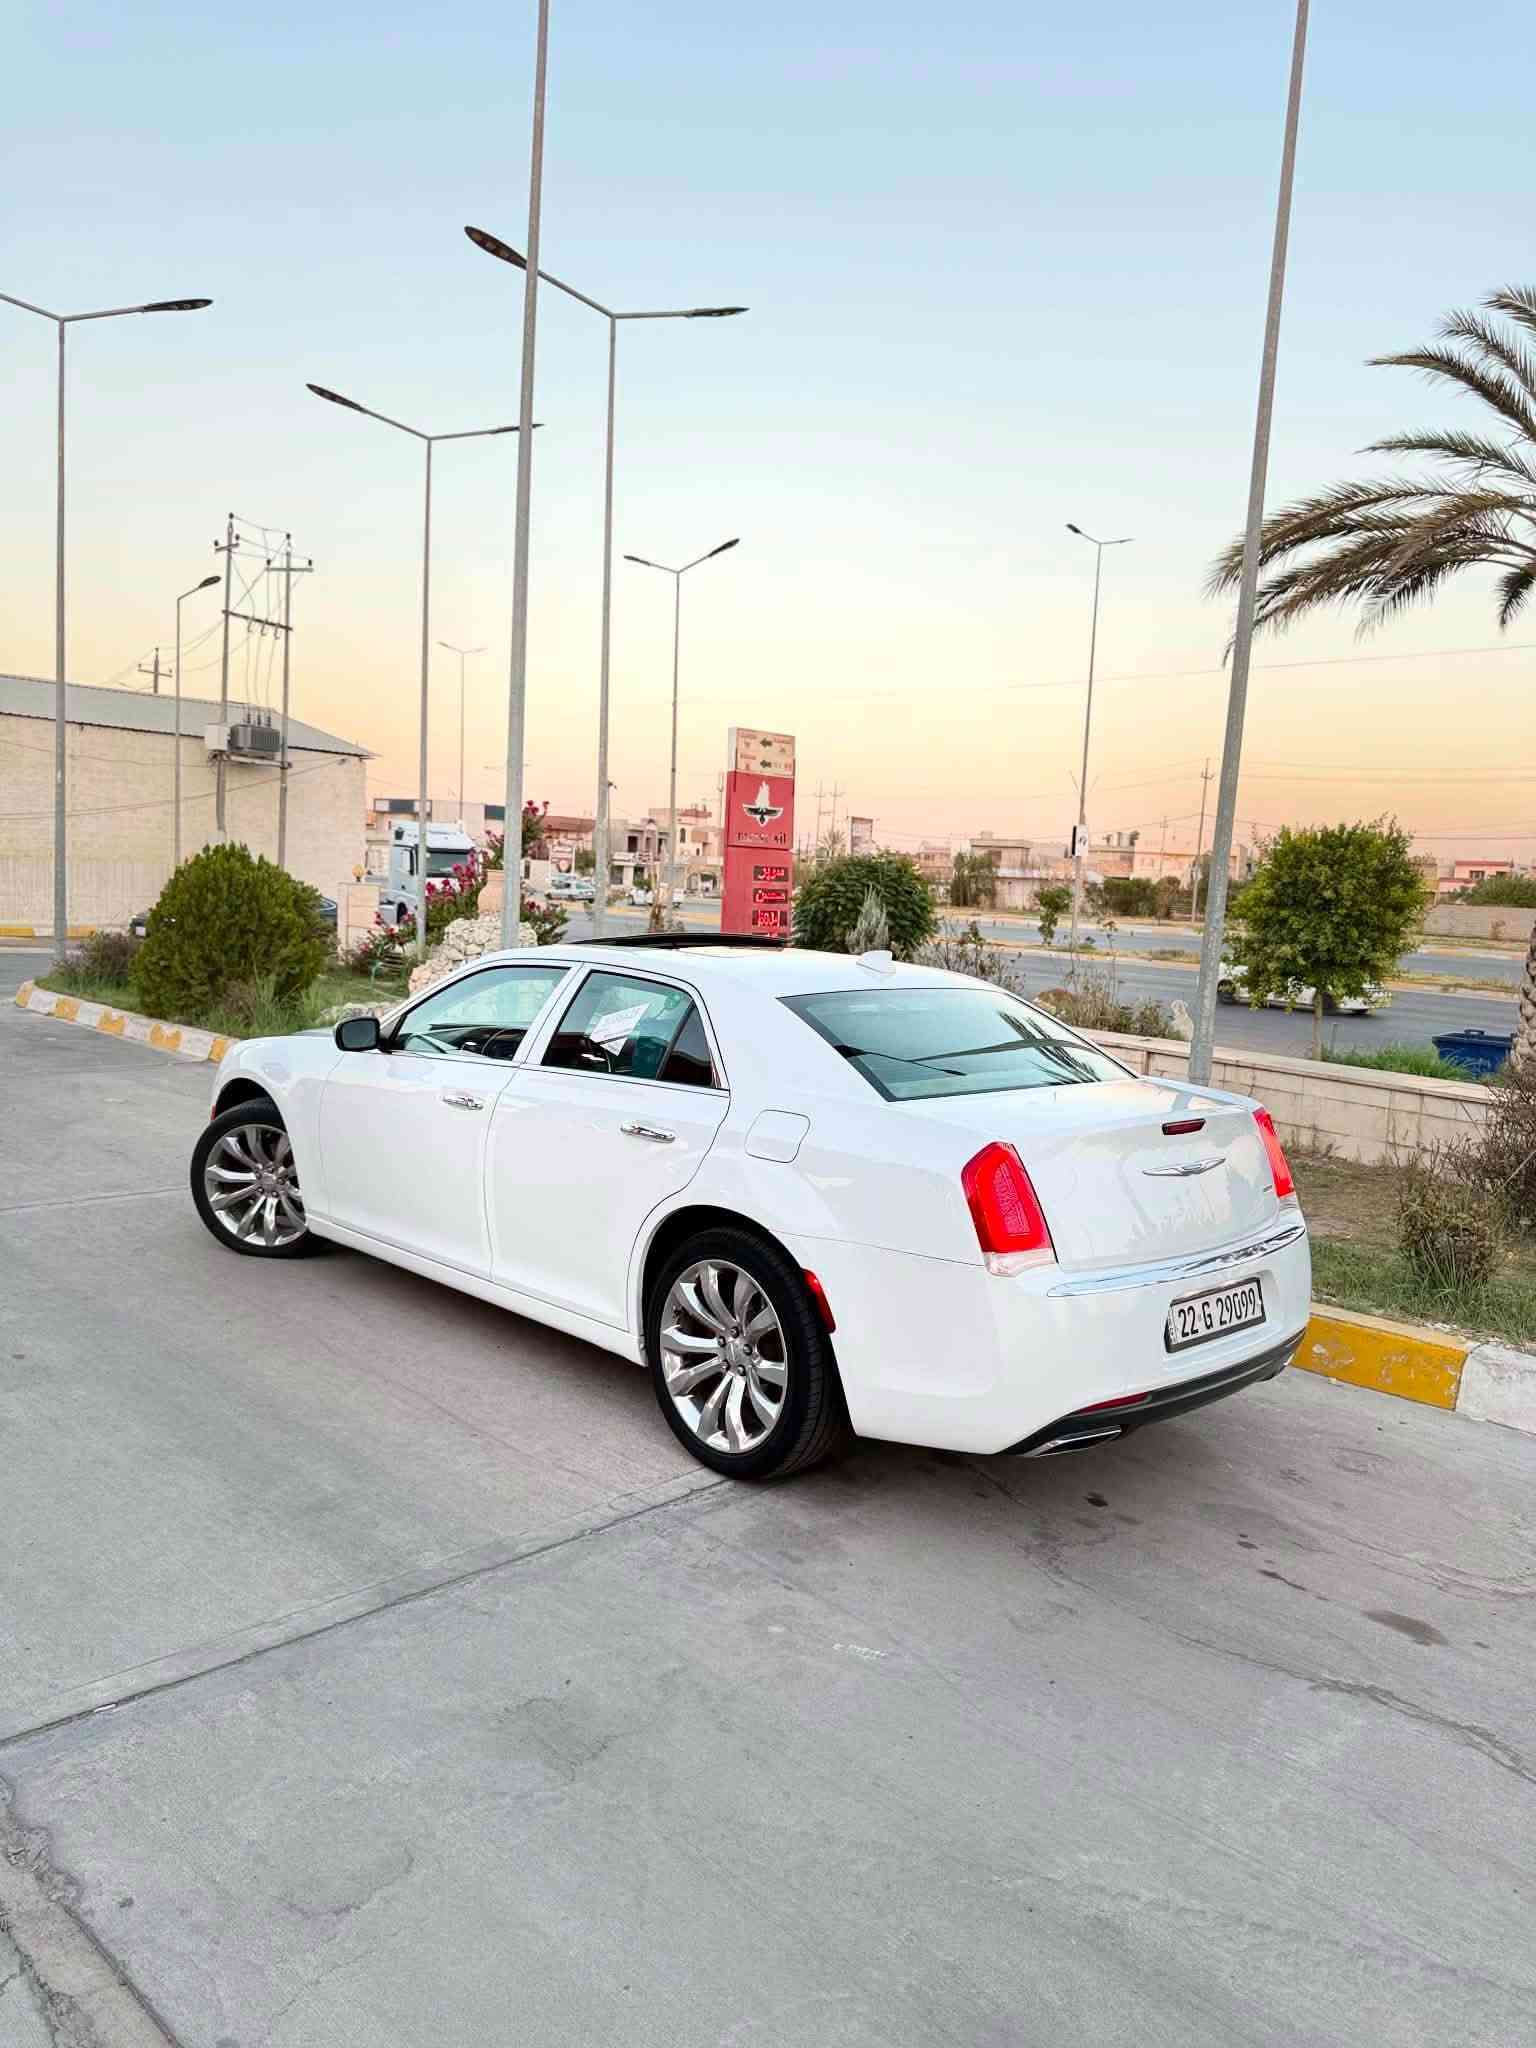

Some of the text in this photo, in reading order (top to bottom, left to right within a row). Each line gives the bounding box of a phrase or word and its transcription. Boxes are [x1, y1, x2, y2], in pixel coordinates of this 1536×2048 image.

[1178, 1305, 1199, 1338] 22
[1201, 1301, 1214, 1330] G
[1216, 1287, 1256, 1327] 29099
